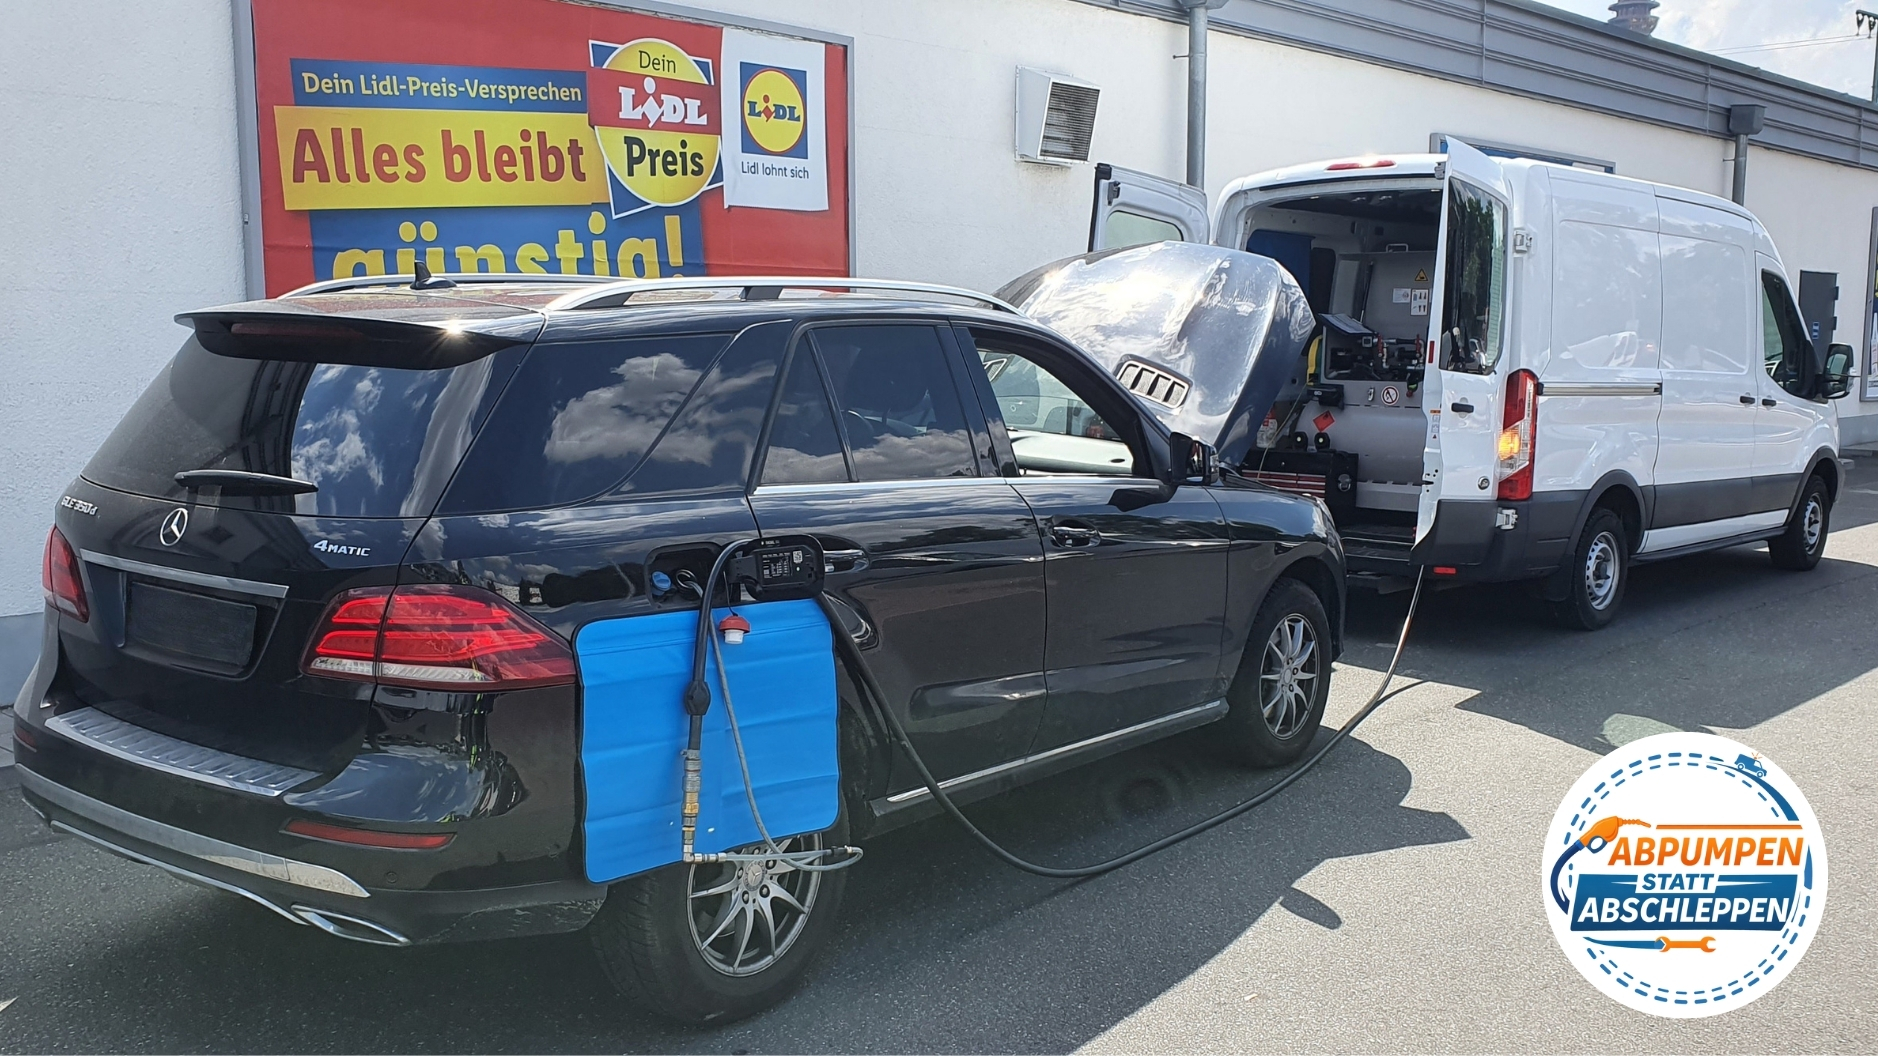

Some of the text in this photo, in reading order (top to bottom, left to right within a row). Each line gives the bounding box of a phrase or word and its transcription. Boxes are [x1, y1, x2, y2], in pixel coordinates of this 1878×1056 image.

[638, 50, 676, 73] Dein
[302, 72, 582, 104] Dein Lidl-Preis-Versprechen
[292, 127, 587, 183] Alles bleibt
[624, 136, 704, 177] Preis
[741, 161, 810, 179] Lidl lohnt sich
[313, 540, 371, 556] 4MATIC
